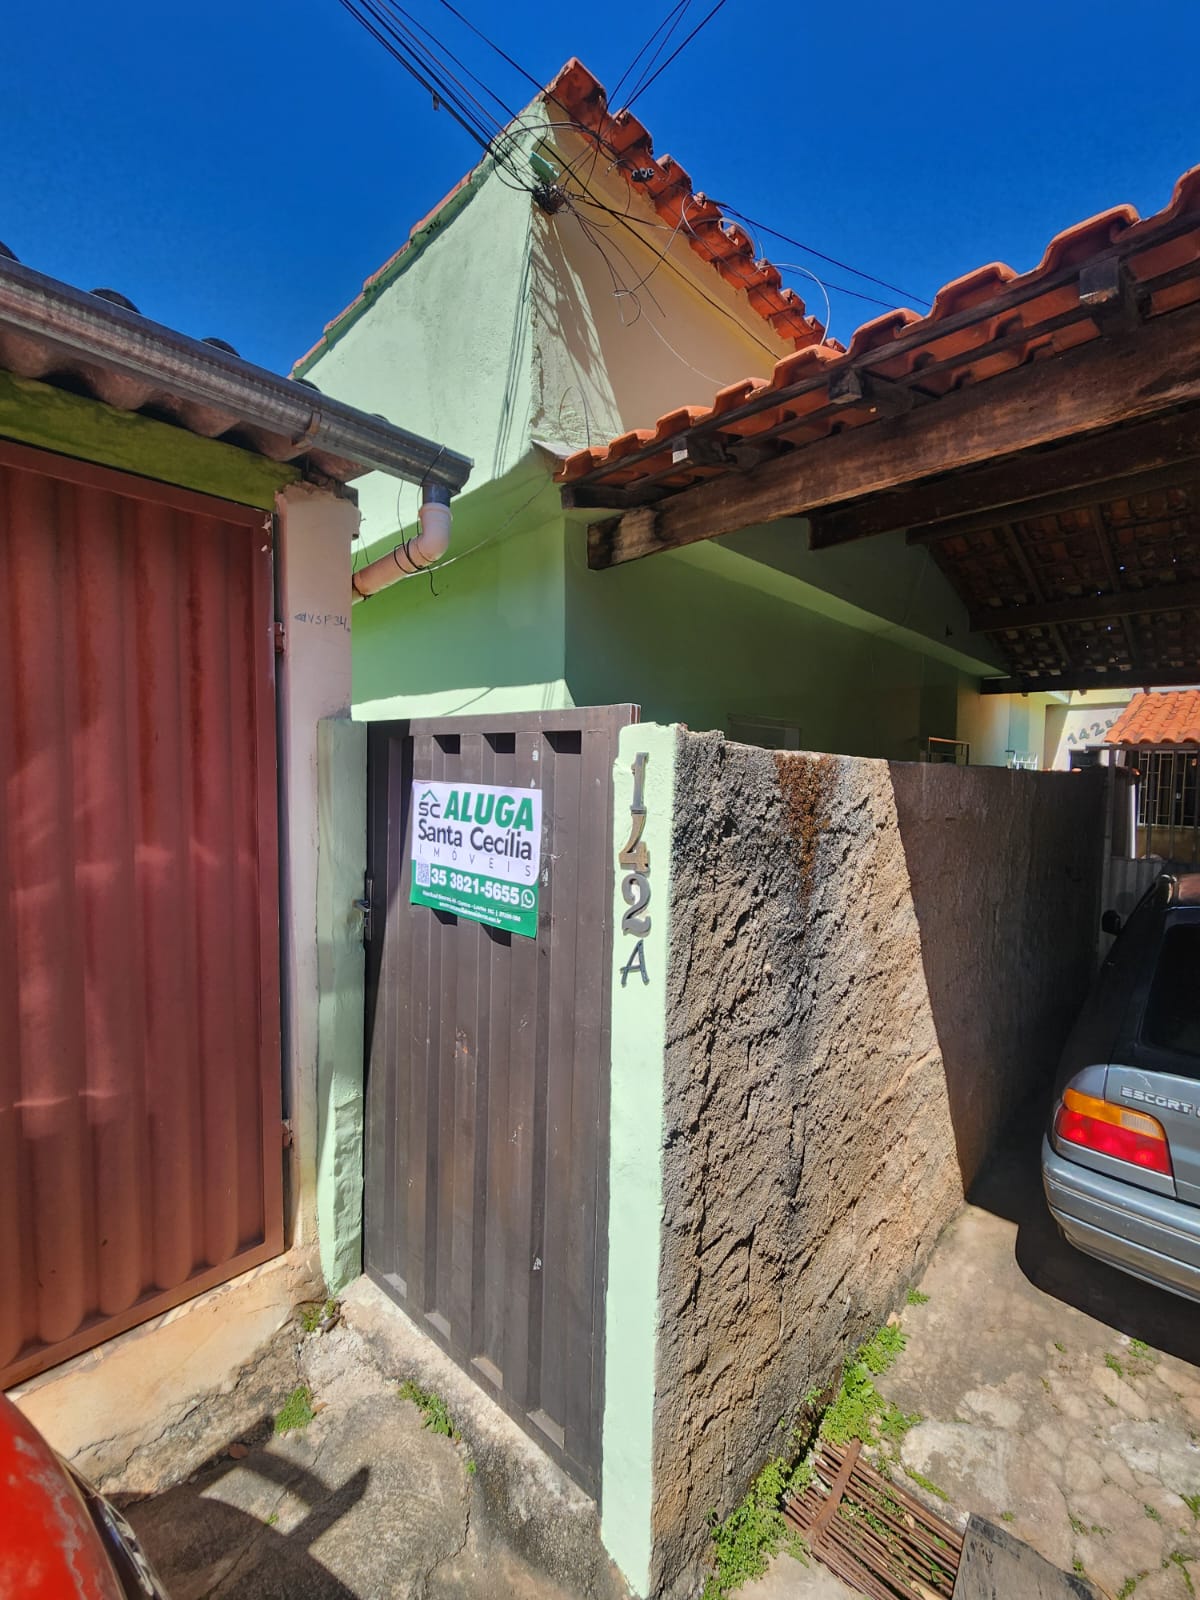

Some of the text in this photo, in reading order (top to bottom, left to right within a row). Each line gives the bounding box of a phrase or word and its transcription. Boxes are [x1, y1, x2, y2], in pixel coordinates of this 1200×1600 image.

[418, 801, 441, 819] SC
[443, 790, 534, 832] ALUGA
[418, 818, 532, 861] Santa Cecília
[419, 844, 532, 878] IMÓVEIS
[431, 868, 520, 905] 35 3821-5655
[1121, 1086, 1193, 1114] ESCORT
